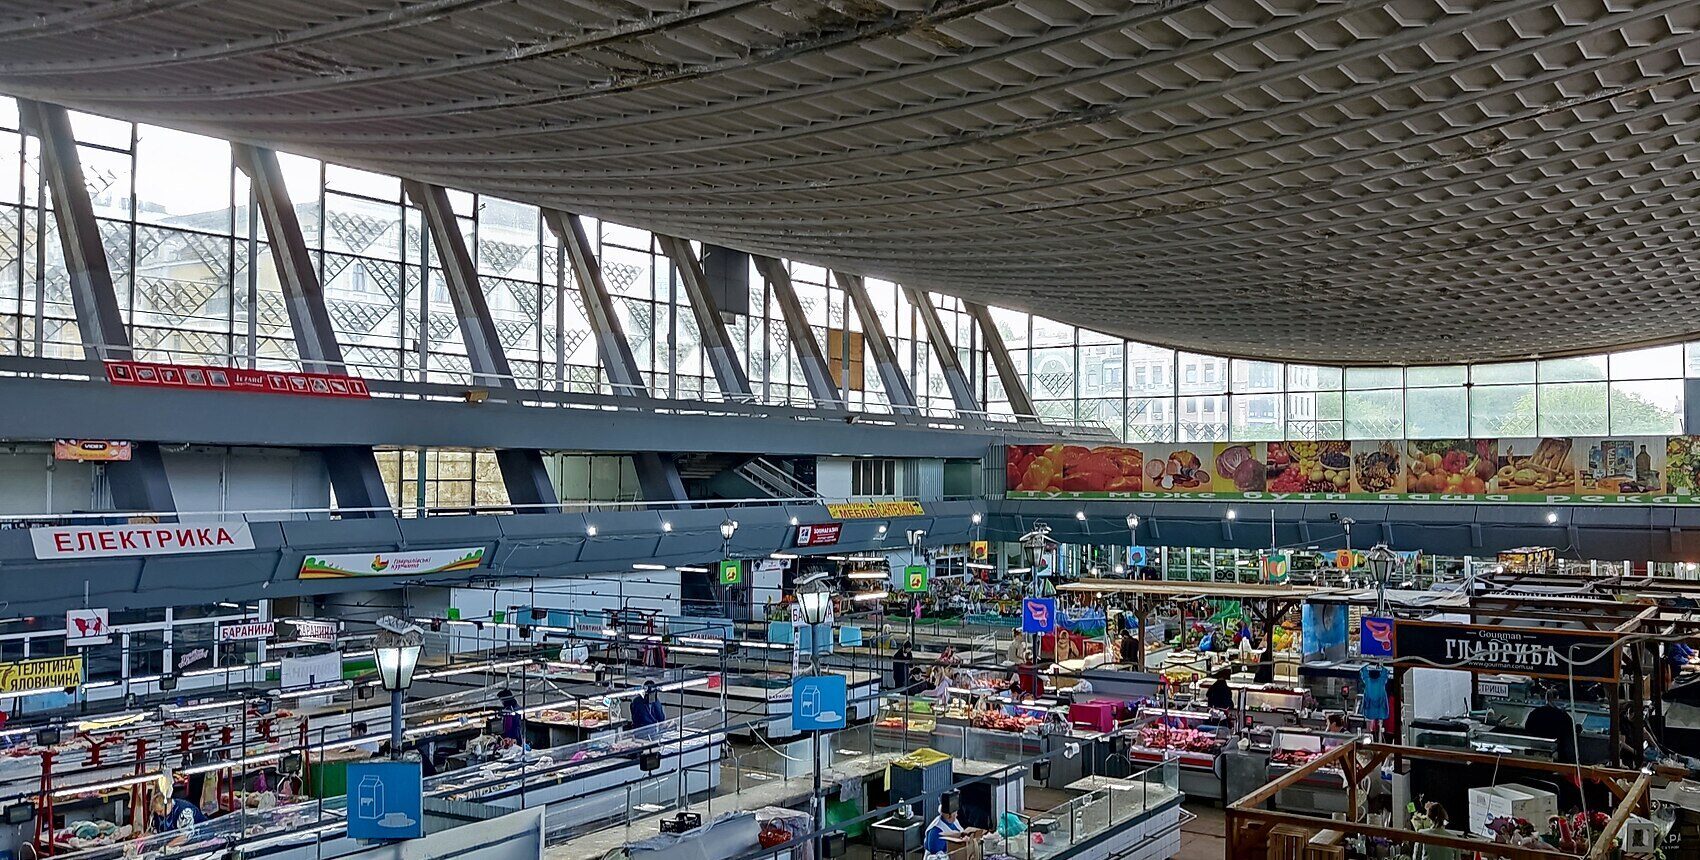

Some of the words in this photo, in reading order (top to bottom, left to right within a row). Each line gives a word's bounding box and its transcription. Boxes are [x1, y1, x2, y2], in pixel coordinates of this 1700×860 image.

[1022, 490, 1082, 498] Тут
[1109, 491, 1216, 499] може
[1243, 491, 1347, 501] бути
[1378, 493, 1509, 502] ваша
[839, 509, 878, 519] МЕБЛІВ
[54, 527, 235, 553] ЕЛЕКТРИКА
[222, 623, 274, 639] БАРАНИНА
[1479, 630, 1522, 641] Gourman
[1446, 638, 1558, 666] ГЛАВРИБА
[17, 658, 75, 676] ТЕЛЯТИНА
[11, 672, 80, 692] ЯЛОВИЧИНА
